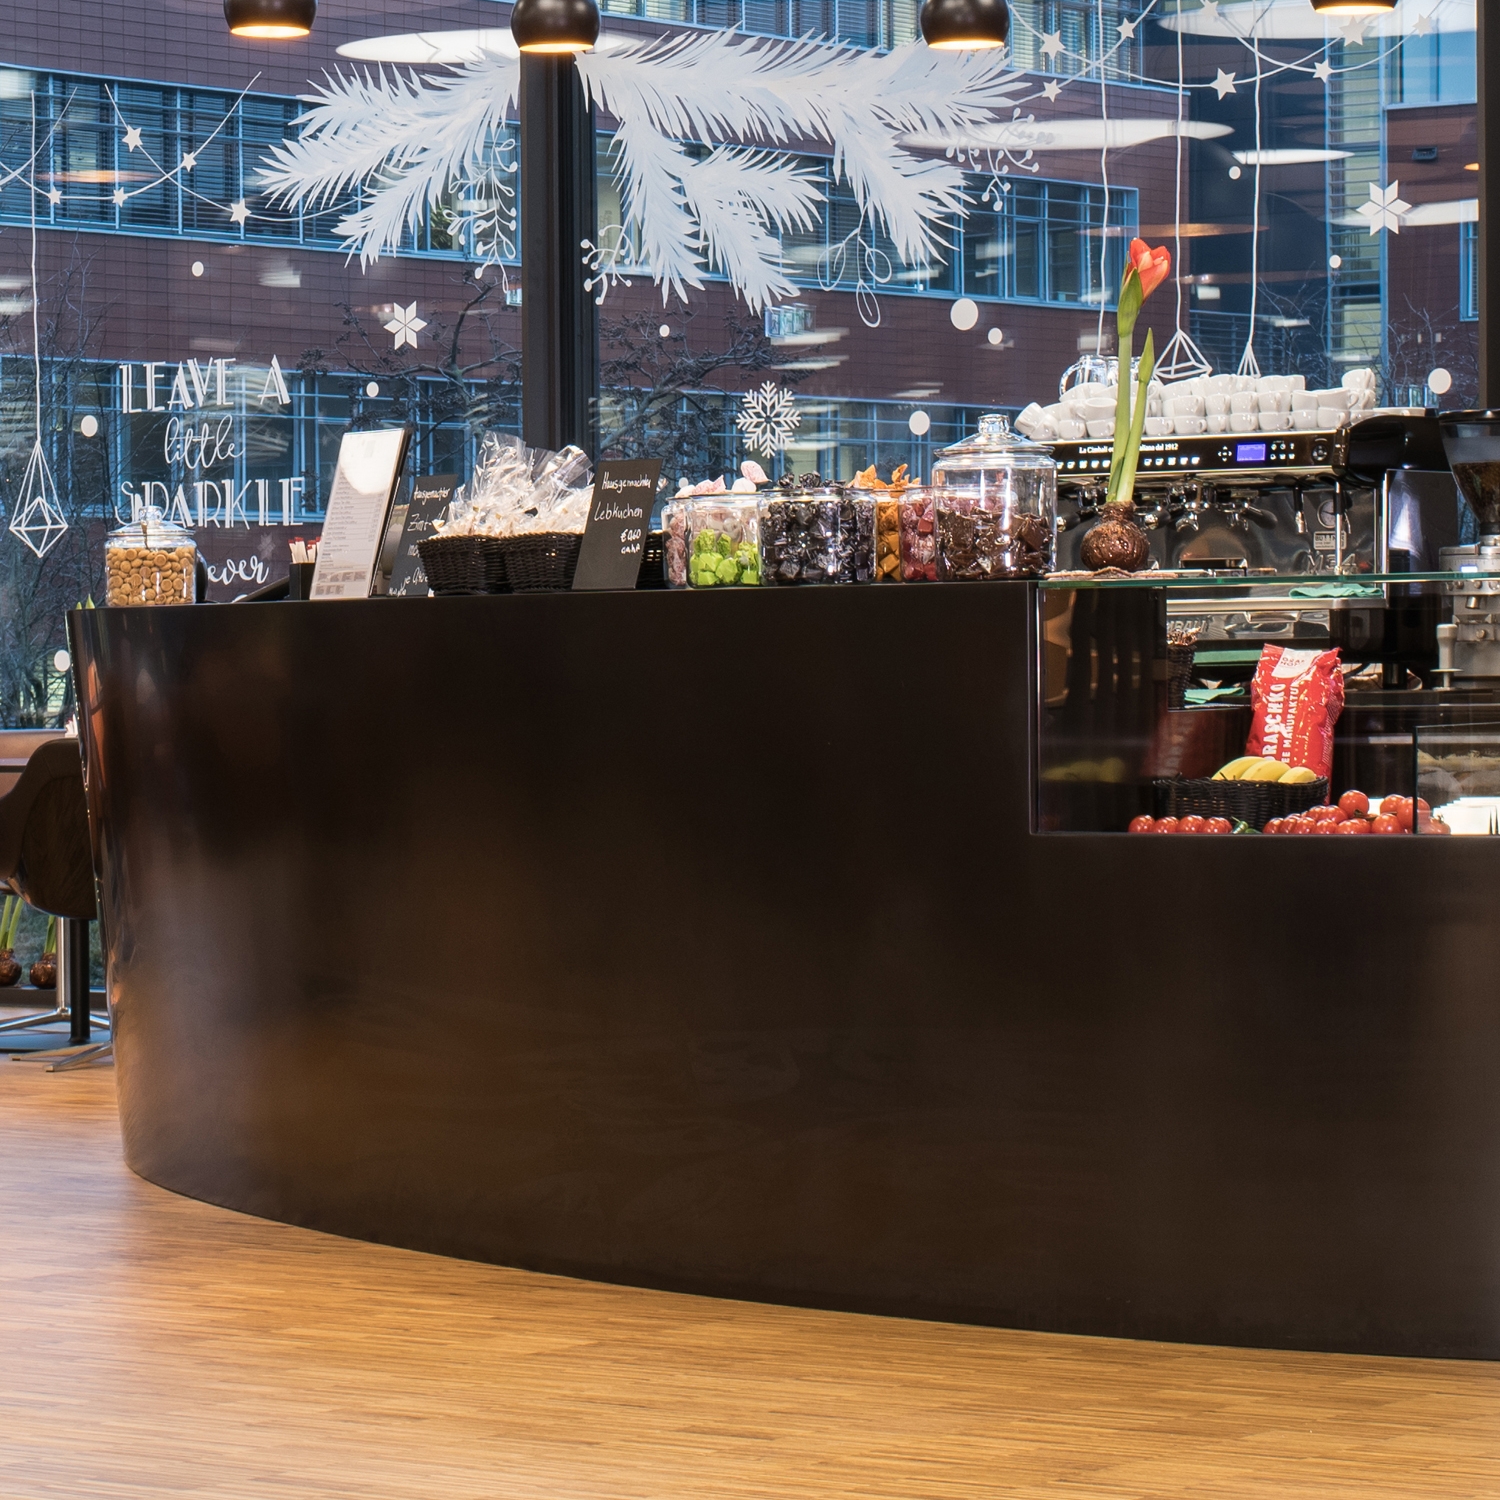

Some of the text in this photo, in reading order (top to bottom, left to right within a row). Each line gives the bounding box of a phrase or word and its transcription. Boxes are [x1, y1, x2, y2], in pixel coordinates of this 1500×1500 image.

[119, 354, 291, 414] LEAVE A
[164, 414, 245, 469] little
[115, 477, 304, 530] SPARKLE
[207, 555, 269, 585] ever
